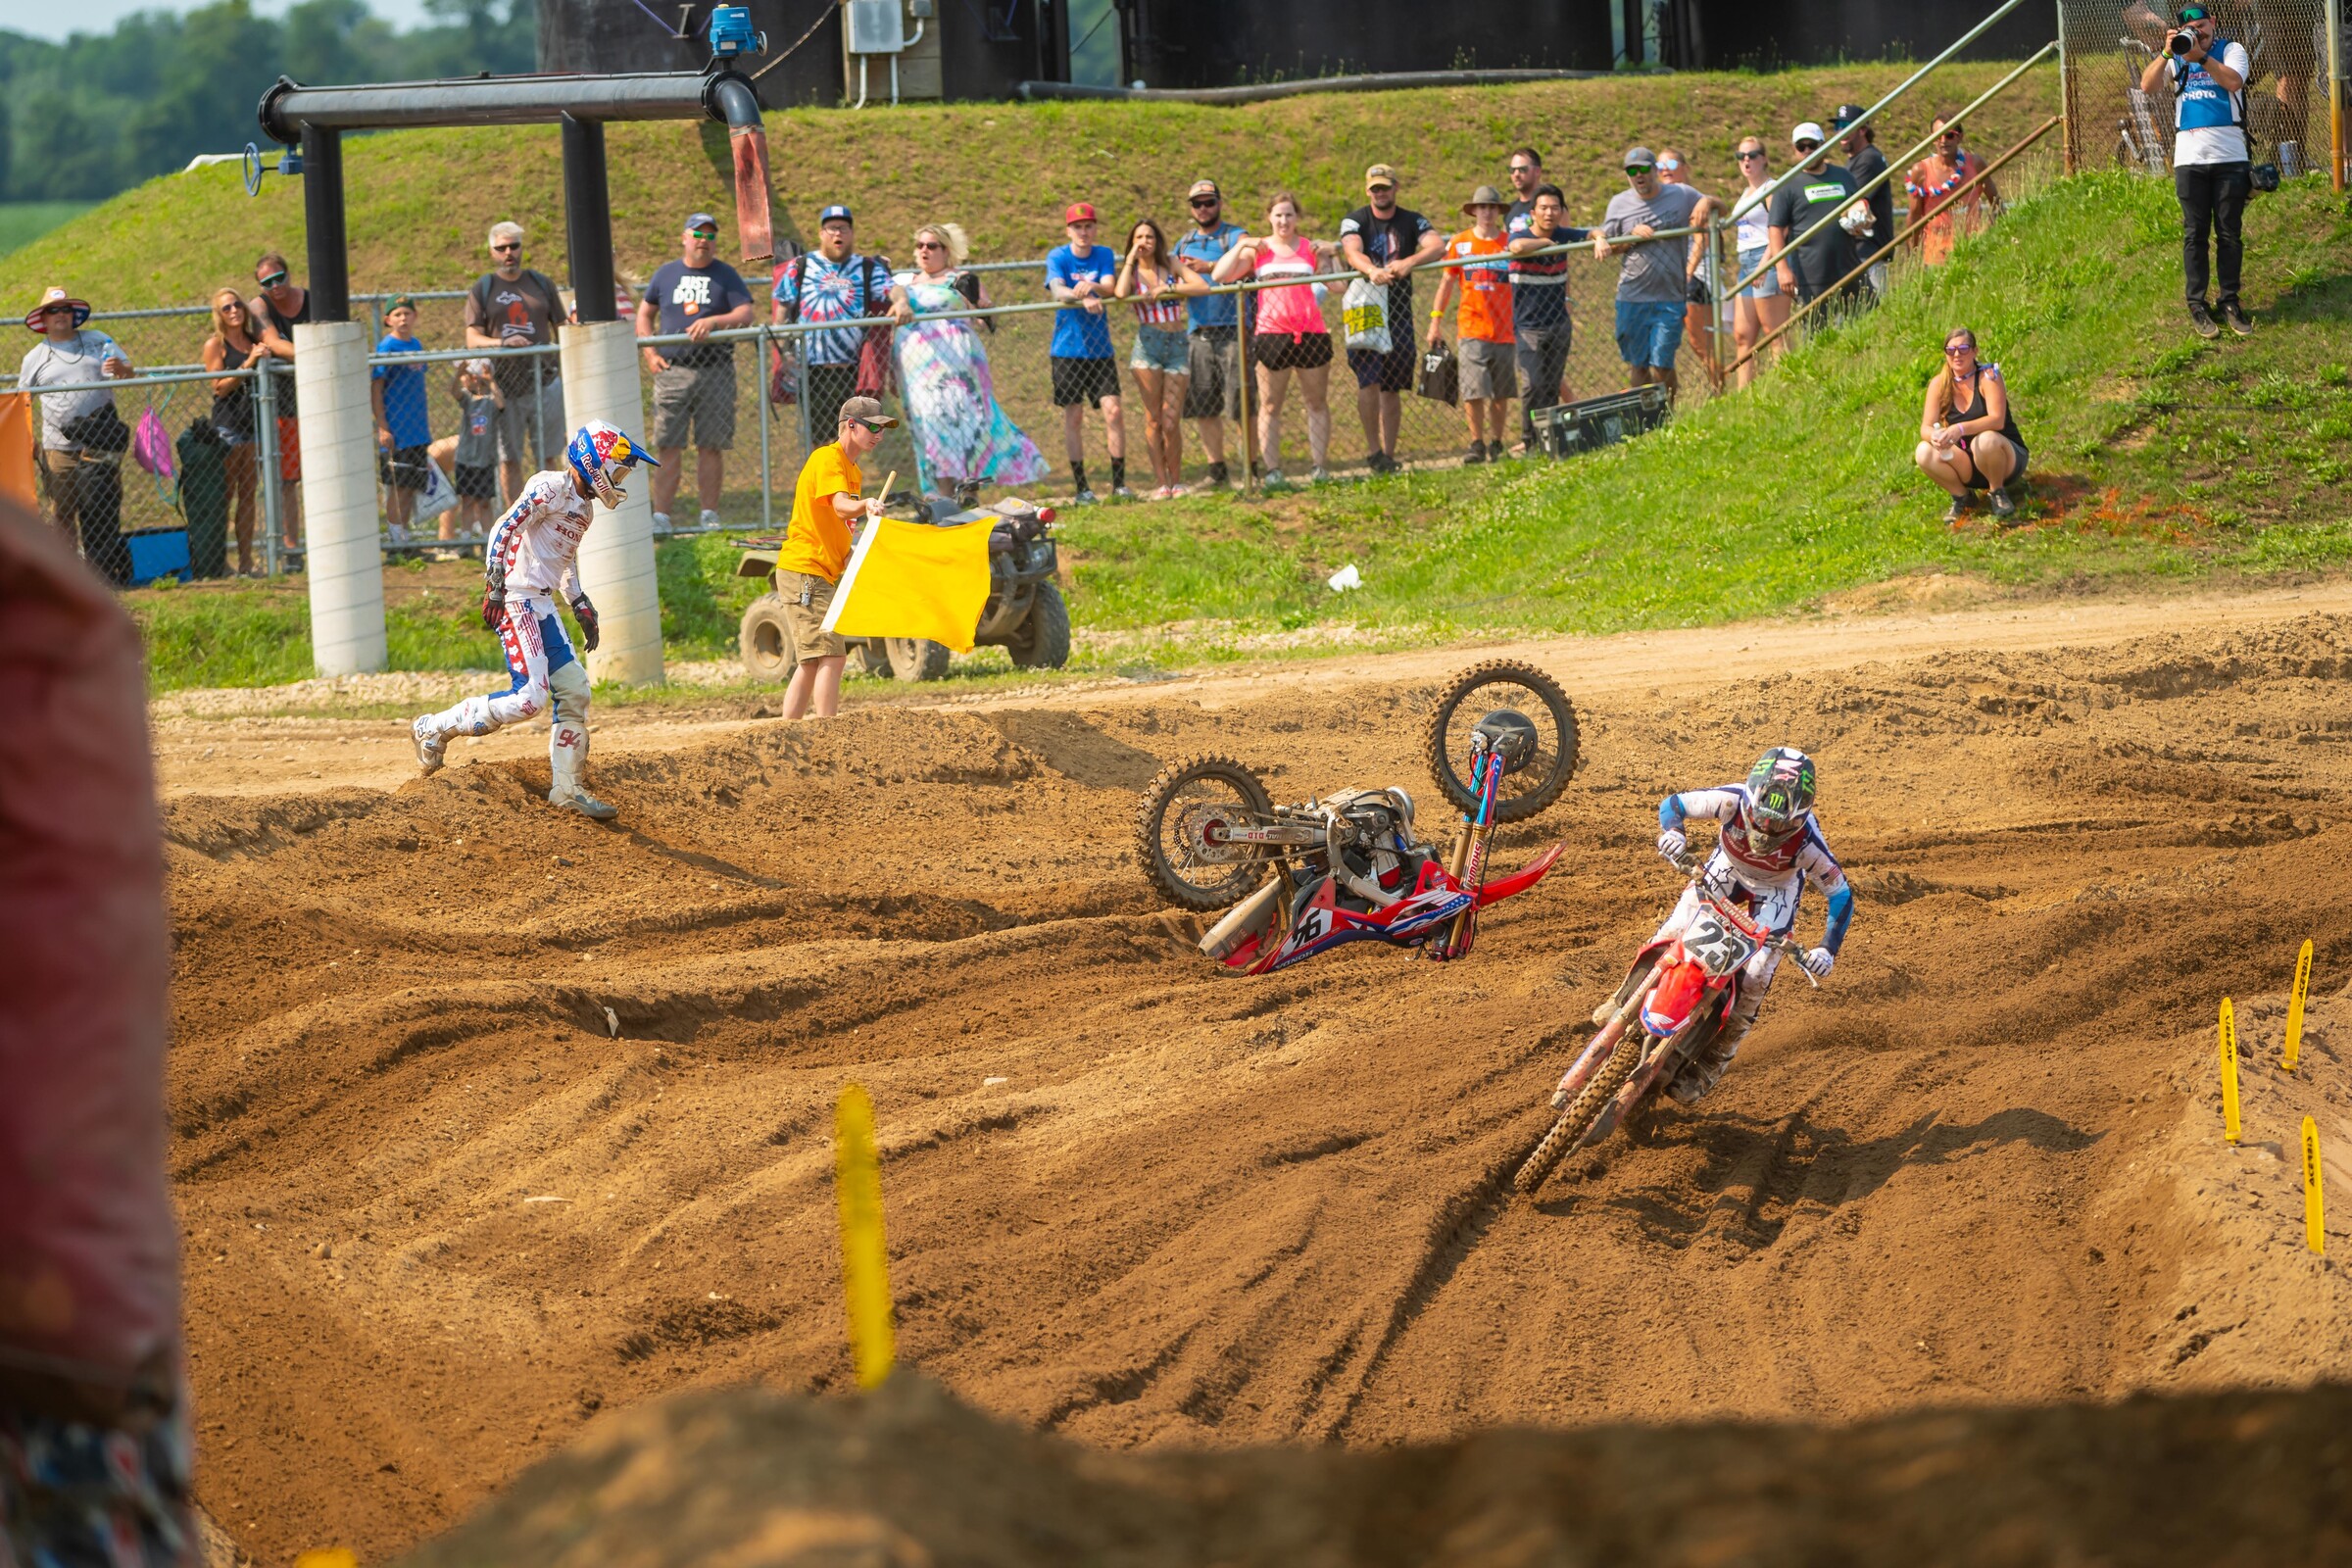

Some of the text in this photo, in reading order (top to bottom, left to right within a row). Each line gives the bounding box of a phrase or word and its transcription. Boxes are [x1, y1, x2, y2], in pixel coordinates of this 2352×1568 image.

[2181, 89, 2217, 102] PHOTO
[677, 275, 711, 290] JUST
[672, 288, 695, 305] DO
[555, 523, 582, 543] HON
[557, 729, 581, 751] 94
[1468, 843, 1483, 887] SHOWA
[1292, 908, 1321, 950] 94
[1684, 920, 1745, 973] 23
[1275, 950, 1313, 969] HONDA
[2306, 1136, 2315, 1187] ACERBIS
